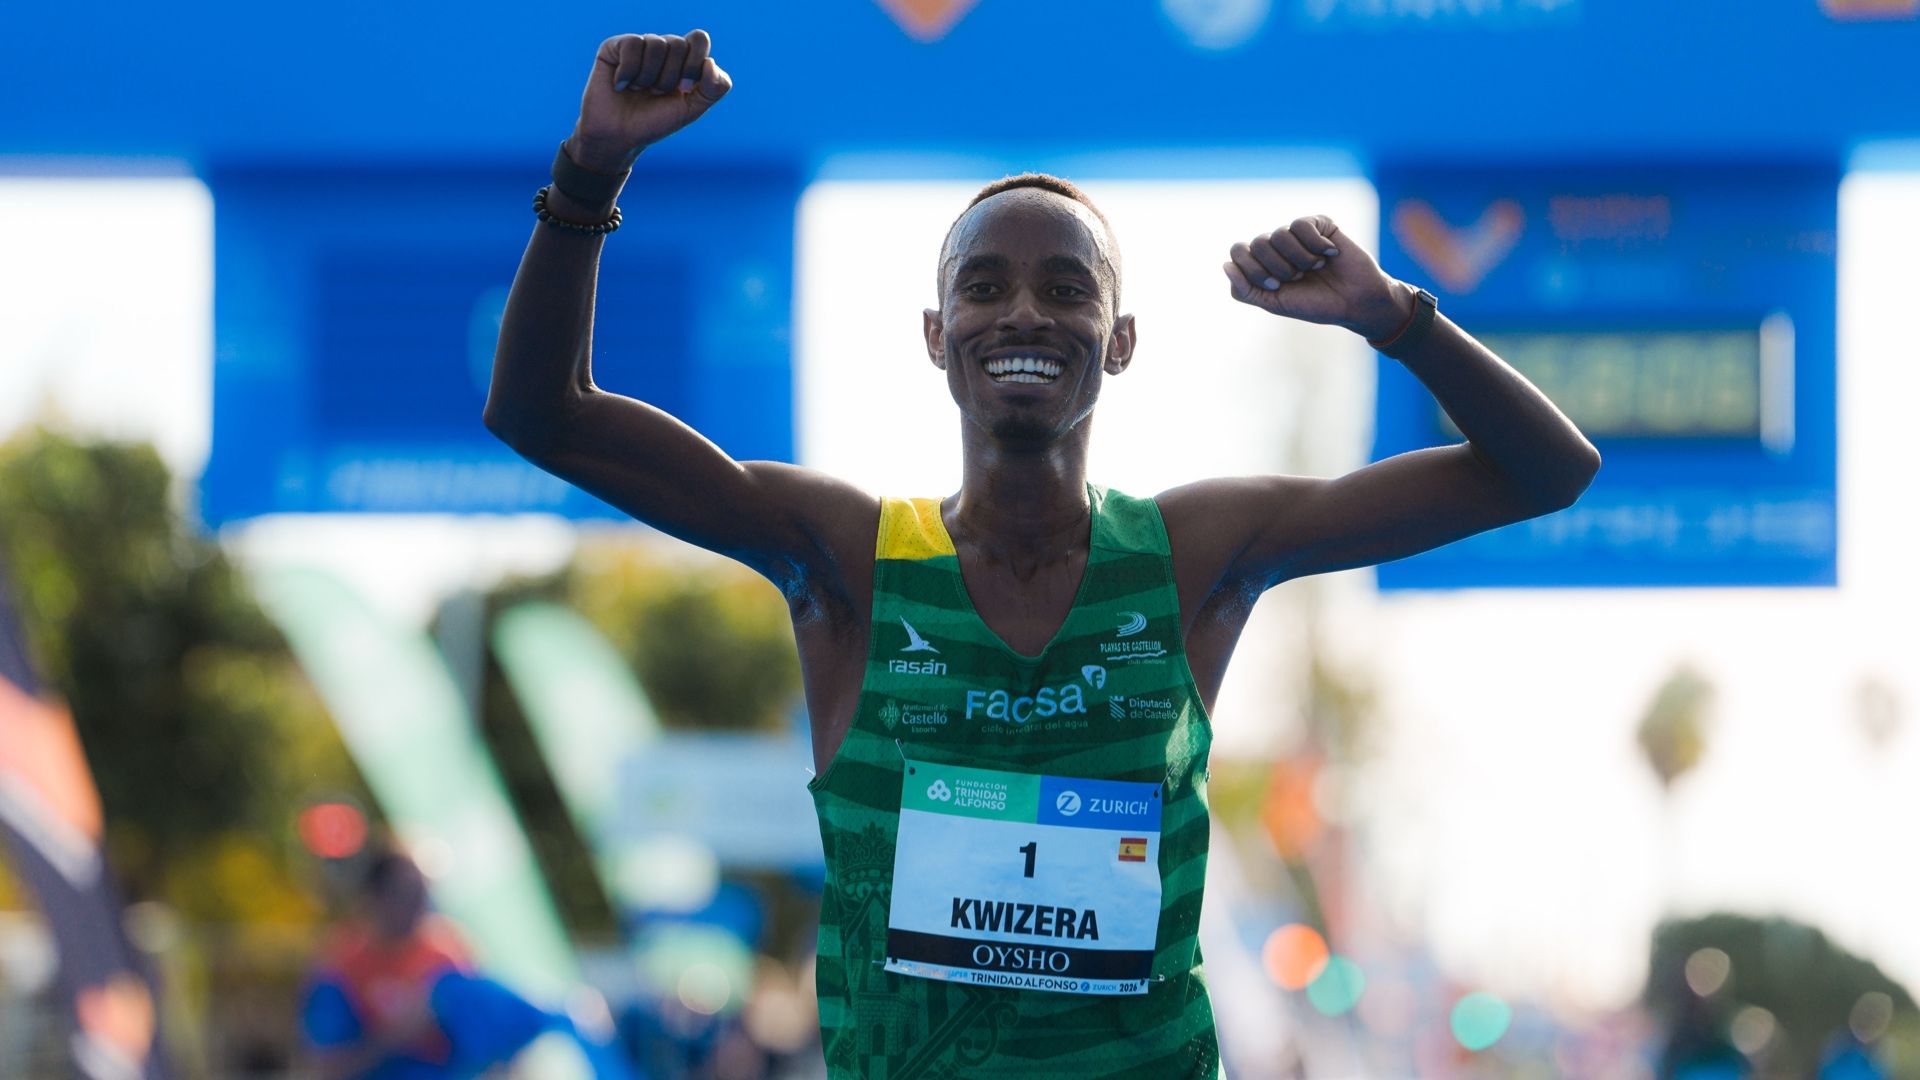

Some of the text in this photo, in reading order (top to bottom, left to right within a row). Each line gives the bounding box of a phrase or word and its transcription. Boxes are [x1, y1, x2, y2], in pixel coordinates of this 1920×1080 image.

[1100, 642, 1121, 653] PLAYAS
[1122, 641, 1130, 652] DE
[889, 659, 947, 675] rasán
[966, 683, 1087, 723] Facsa
[1129, 697, 1172, 709] Diputació
[902, 711, 948, 725] Castelló
[1130, 709, 1178, 720] de Castelló
[1044, 719, 1060, 730] del
[1064, 719, 1089, 730] agua
[955, 786, 1007, 801] TRINIDAD
[954, 798, 1006, 811] ALFONSO
[1089, 798, 1148, 816] ZURICH
[1019, 841, 1037, 878] 1
[950, 897, 1099, 941] KWIZERA
[972, 944, 1070, 973] OYSHO
[971, 972, 1023, 987] TRINIDAD
[1024, 977, 1078, 991] ALFONSO
[1119, 983, 1138, 993] 2026
